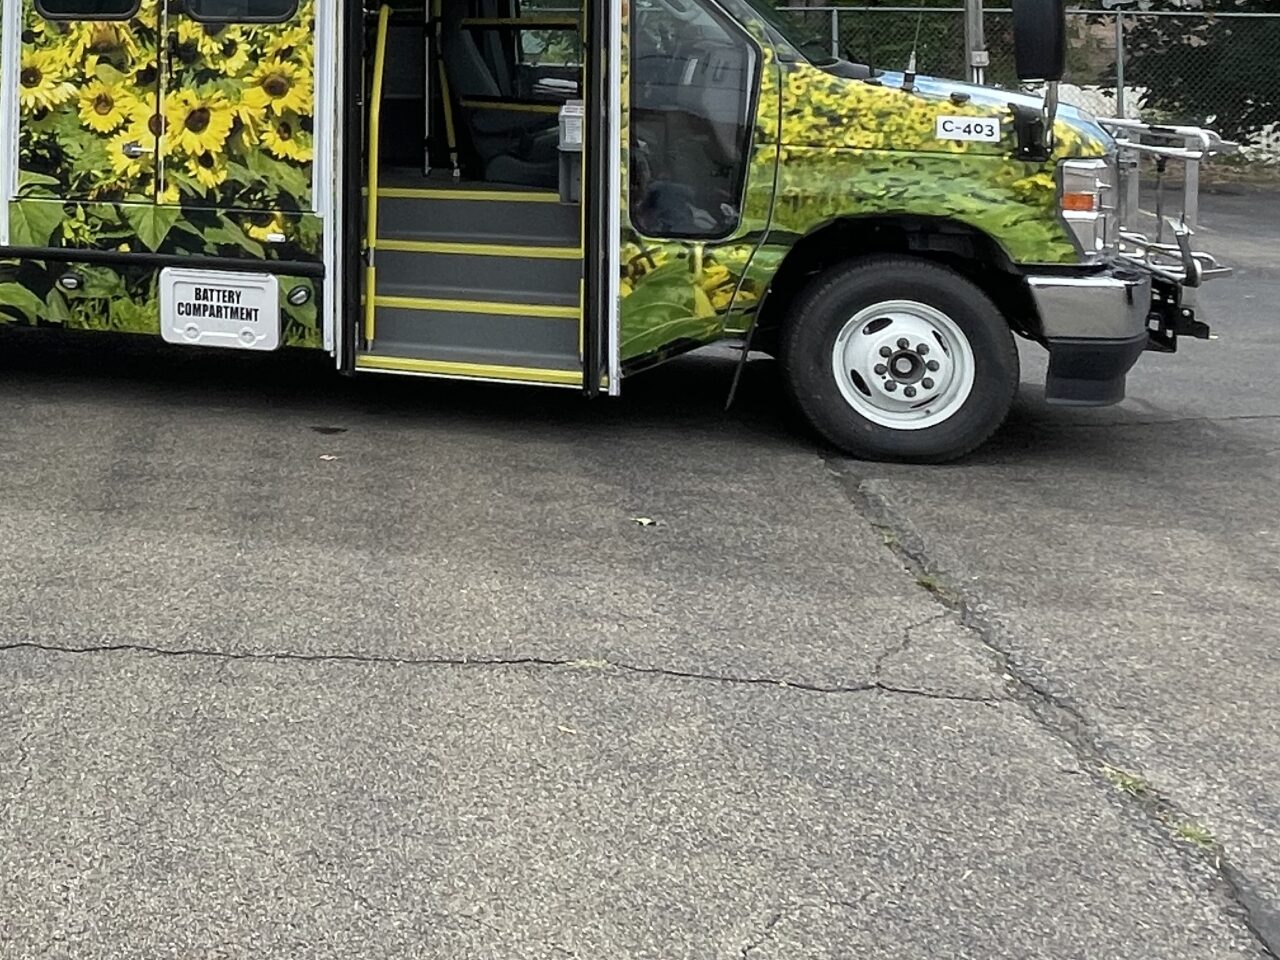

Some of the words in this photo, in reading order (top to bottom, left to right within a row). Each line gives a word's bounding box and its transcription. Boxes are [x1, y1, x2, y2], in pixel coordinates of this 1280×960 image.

[942, 120, 995, 137] C-403
[194, 287, 241, 304] BATTERY
[177, 302, 259, 321] COMPARTMENT
